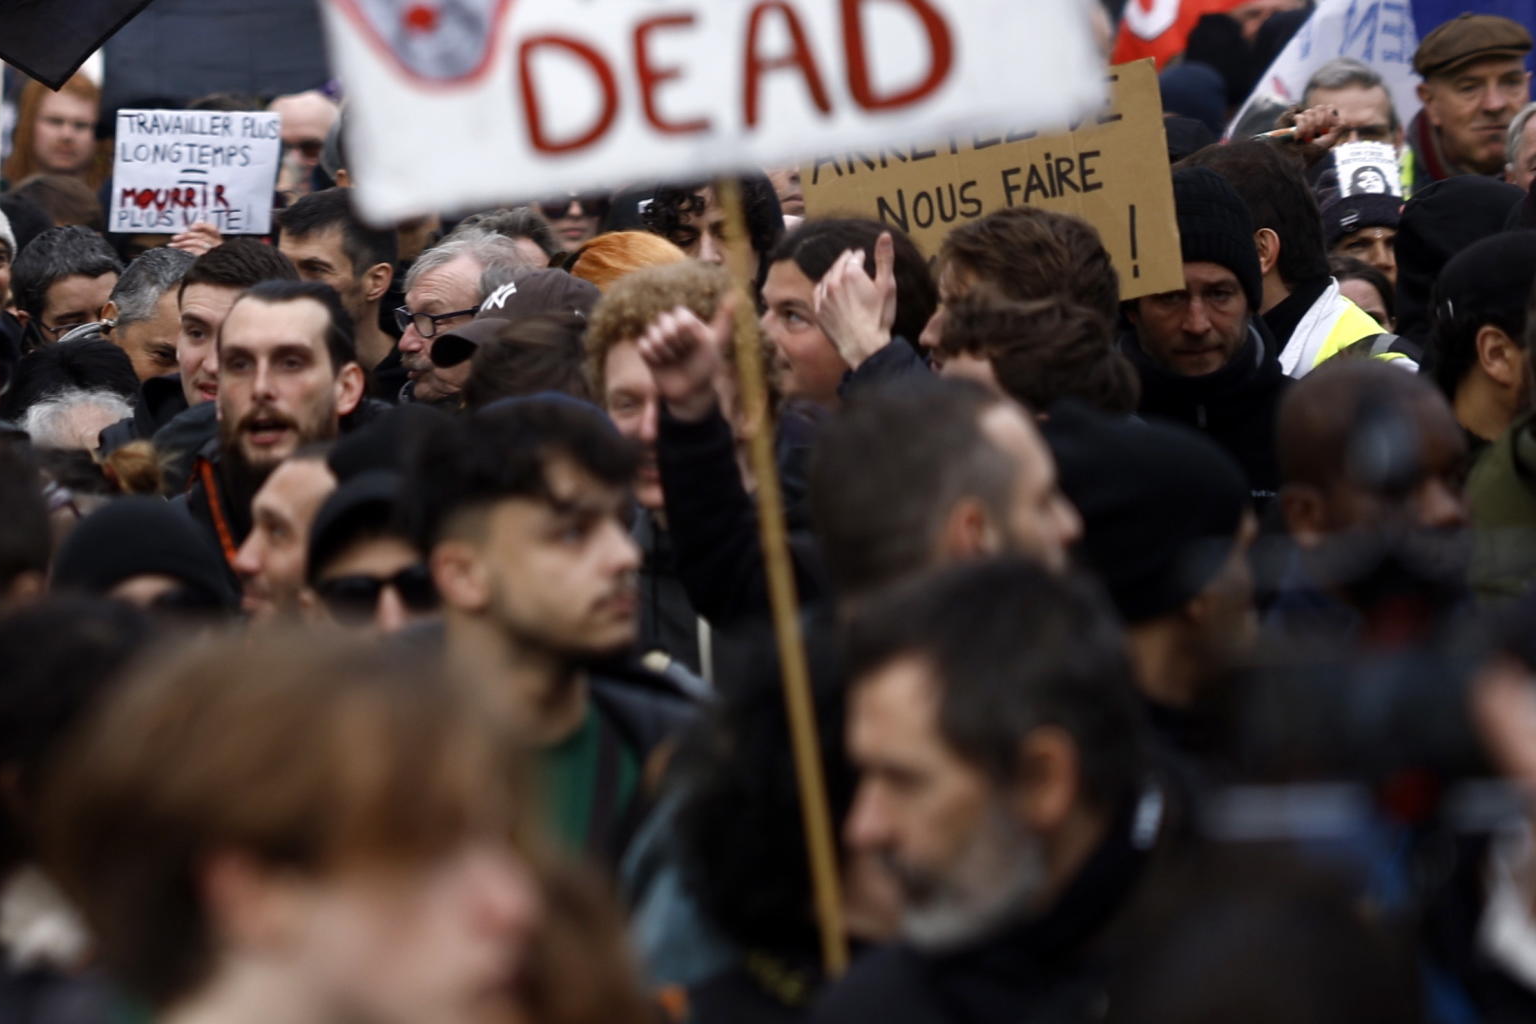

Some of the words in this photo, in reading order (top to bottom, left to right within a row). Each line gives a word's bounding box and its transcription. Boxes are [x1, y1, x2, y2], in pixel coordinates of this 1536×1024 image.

[118, 113, 233, 137] TRAVAILLER
[242, 117, 280, 139] PLUS
[120, 142, 251, 167] LONGTEMPS
[118, 209, 175, 227] PLUS
[876, 180, 982, 233] NOUS
